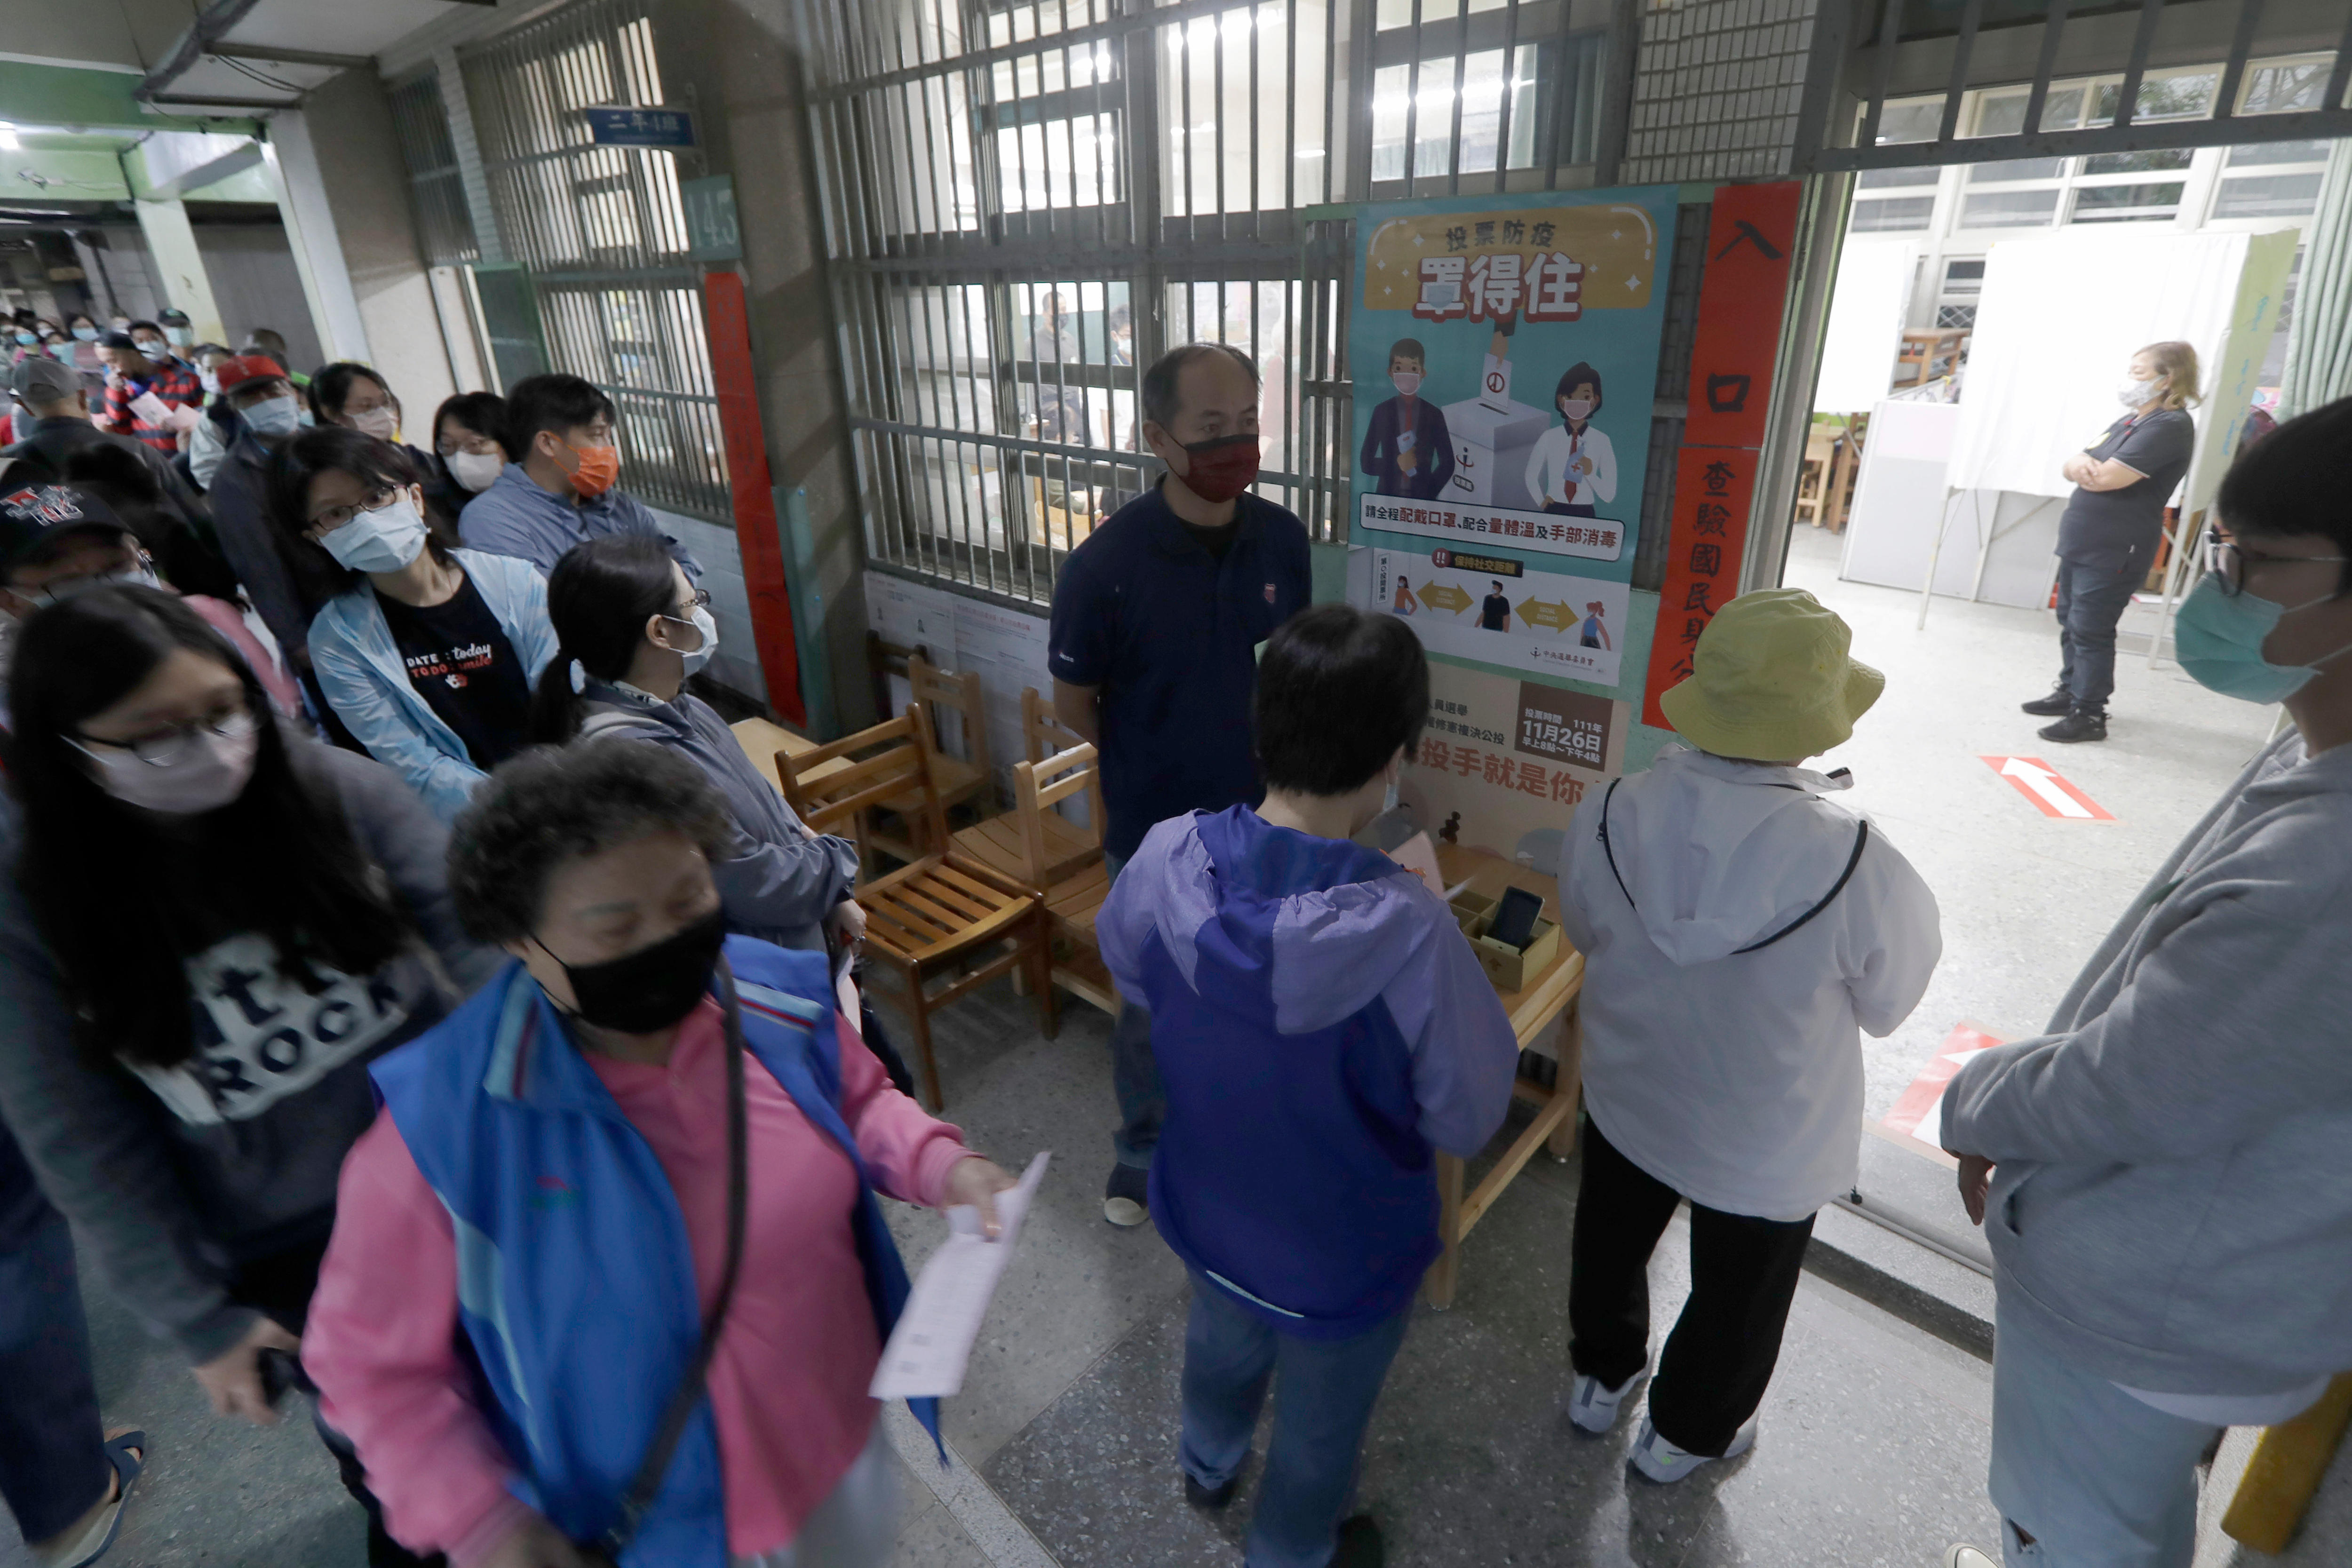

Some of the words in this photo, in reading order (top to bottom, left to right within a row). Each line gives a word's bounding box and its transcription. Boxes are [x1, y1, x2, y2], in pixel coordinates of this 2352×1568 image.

[1446, 219, 1556, 252] 投票防疫
[1414, 251, 1583, 319] 罩得住
[1708, 219, 1784, 413] 入口
[1454, 555, 1516, 574] 保持社交距離
[406, 653, 439, 667] DATE
[452, 643, 492, 660] today
[1430, 699, 1468, 716] 員選舉
[1525, 708, 1562, 725] 投票時間
[1573, 719, 1603, 733] 111年
[1523, 720, 1601, 752] 11月26日
[1406, 737, 1600, 805] 投手就是你
